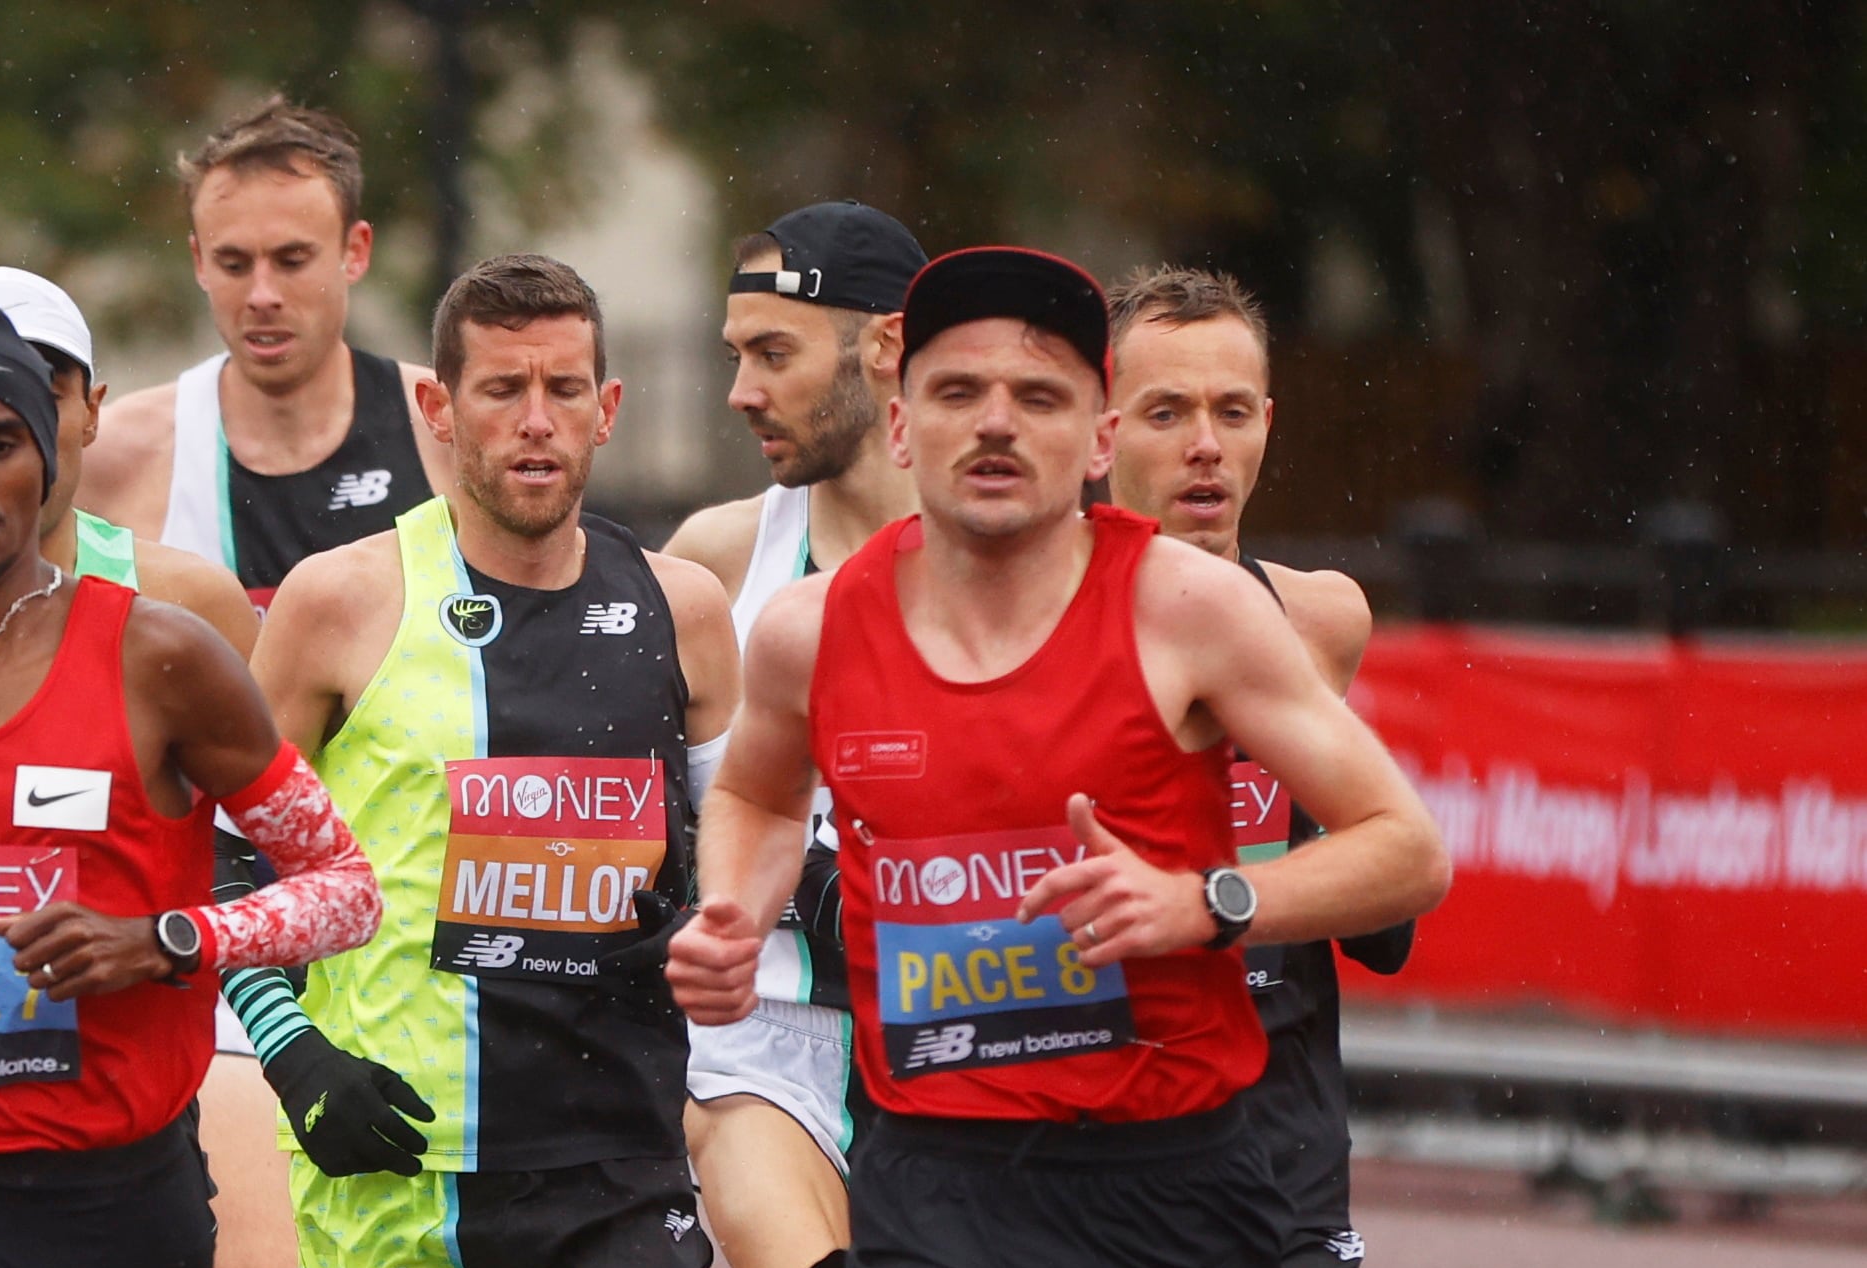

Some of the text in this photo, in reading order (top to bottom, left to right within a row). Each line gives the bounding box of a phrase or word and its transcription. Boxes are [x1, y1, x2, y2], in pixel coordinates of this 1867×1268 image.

[461, 774, 653, 821] MONEY
[453, 860, 649, 924] MELLOR
[522, 958, 561, 974] new
[898, 942, 1096, 1013] PACE 8
[978, 1040, 1022, 1059] new
[1024, 1029, 1113, 1052] balance
